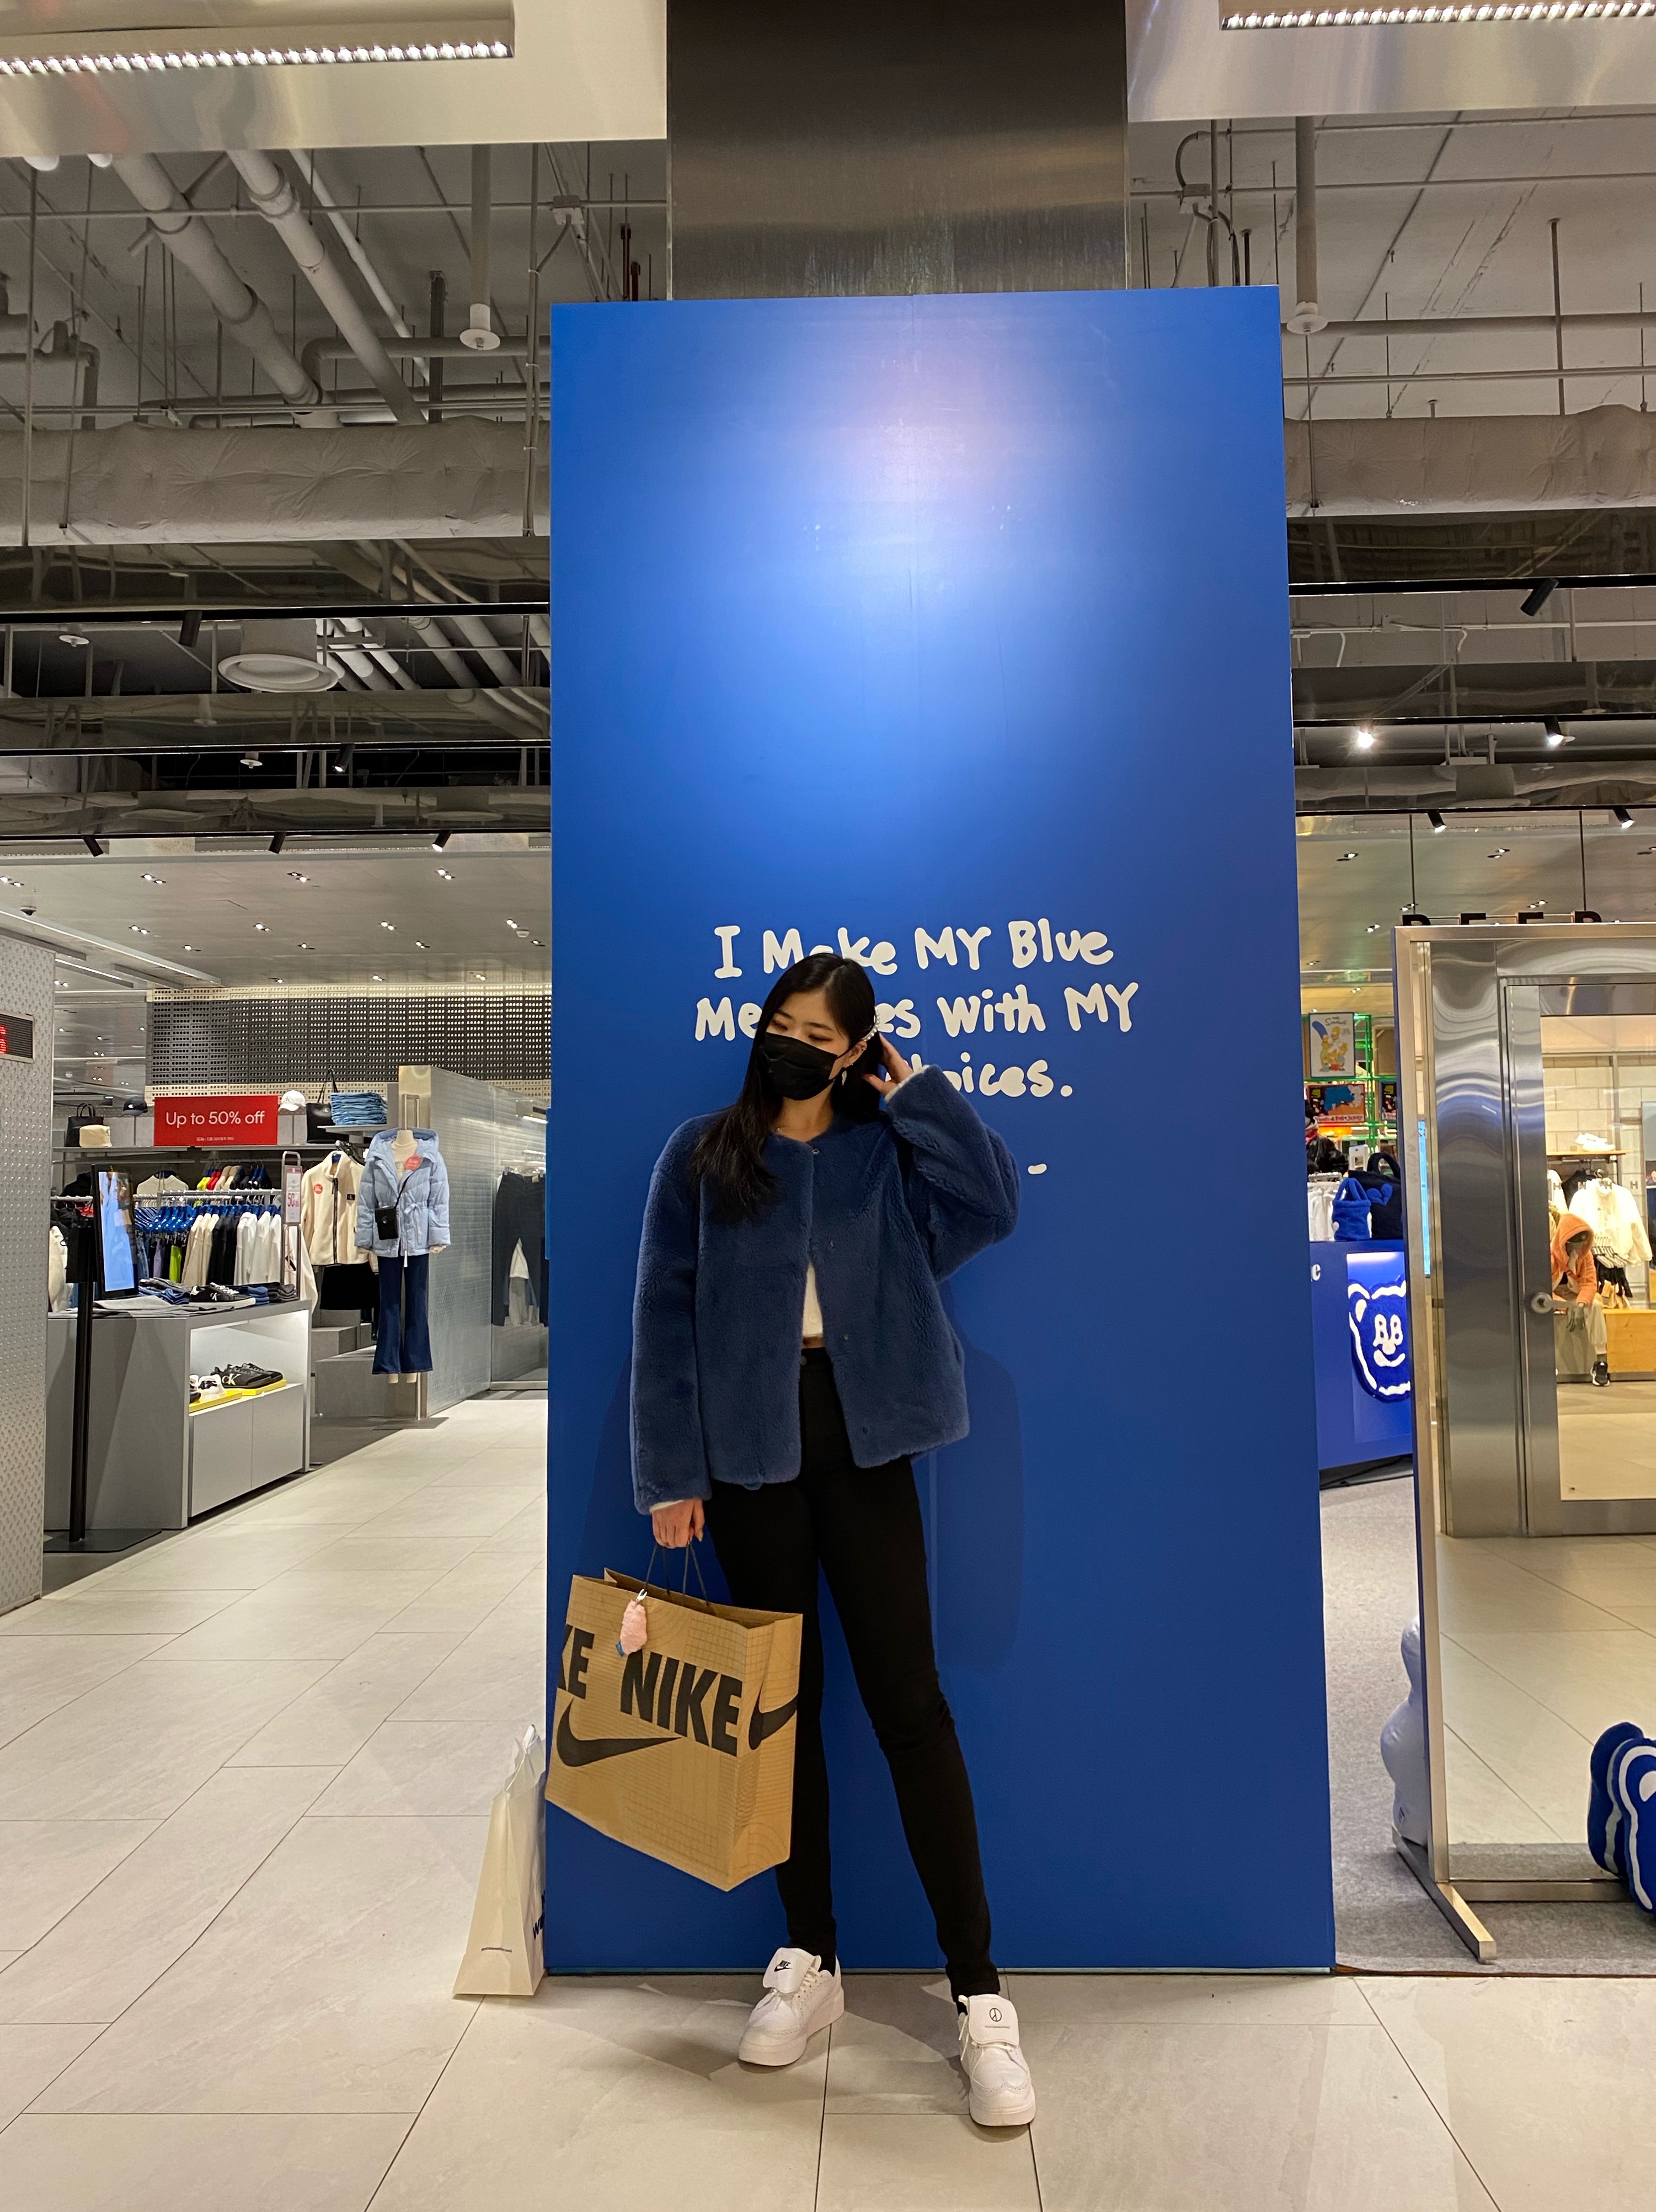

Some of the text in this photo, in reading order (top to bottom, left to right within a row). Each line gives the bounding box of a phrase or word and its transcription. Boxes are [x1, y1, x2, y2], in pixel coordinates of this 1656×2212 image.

[714, 925, 742, 978] I
[915, 926, 991, 971] MY
[1008, 918, 1114, 968] Blue
[1064, 982, 1139, 1032] MY
[166, 1110, 265, 1128] Up to 50% off
[222, 1373, 241, 1385] CK
[621, 1649, 742, 1757] NIKE
